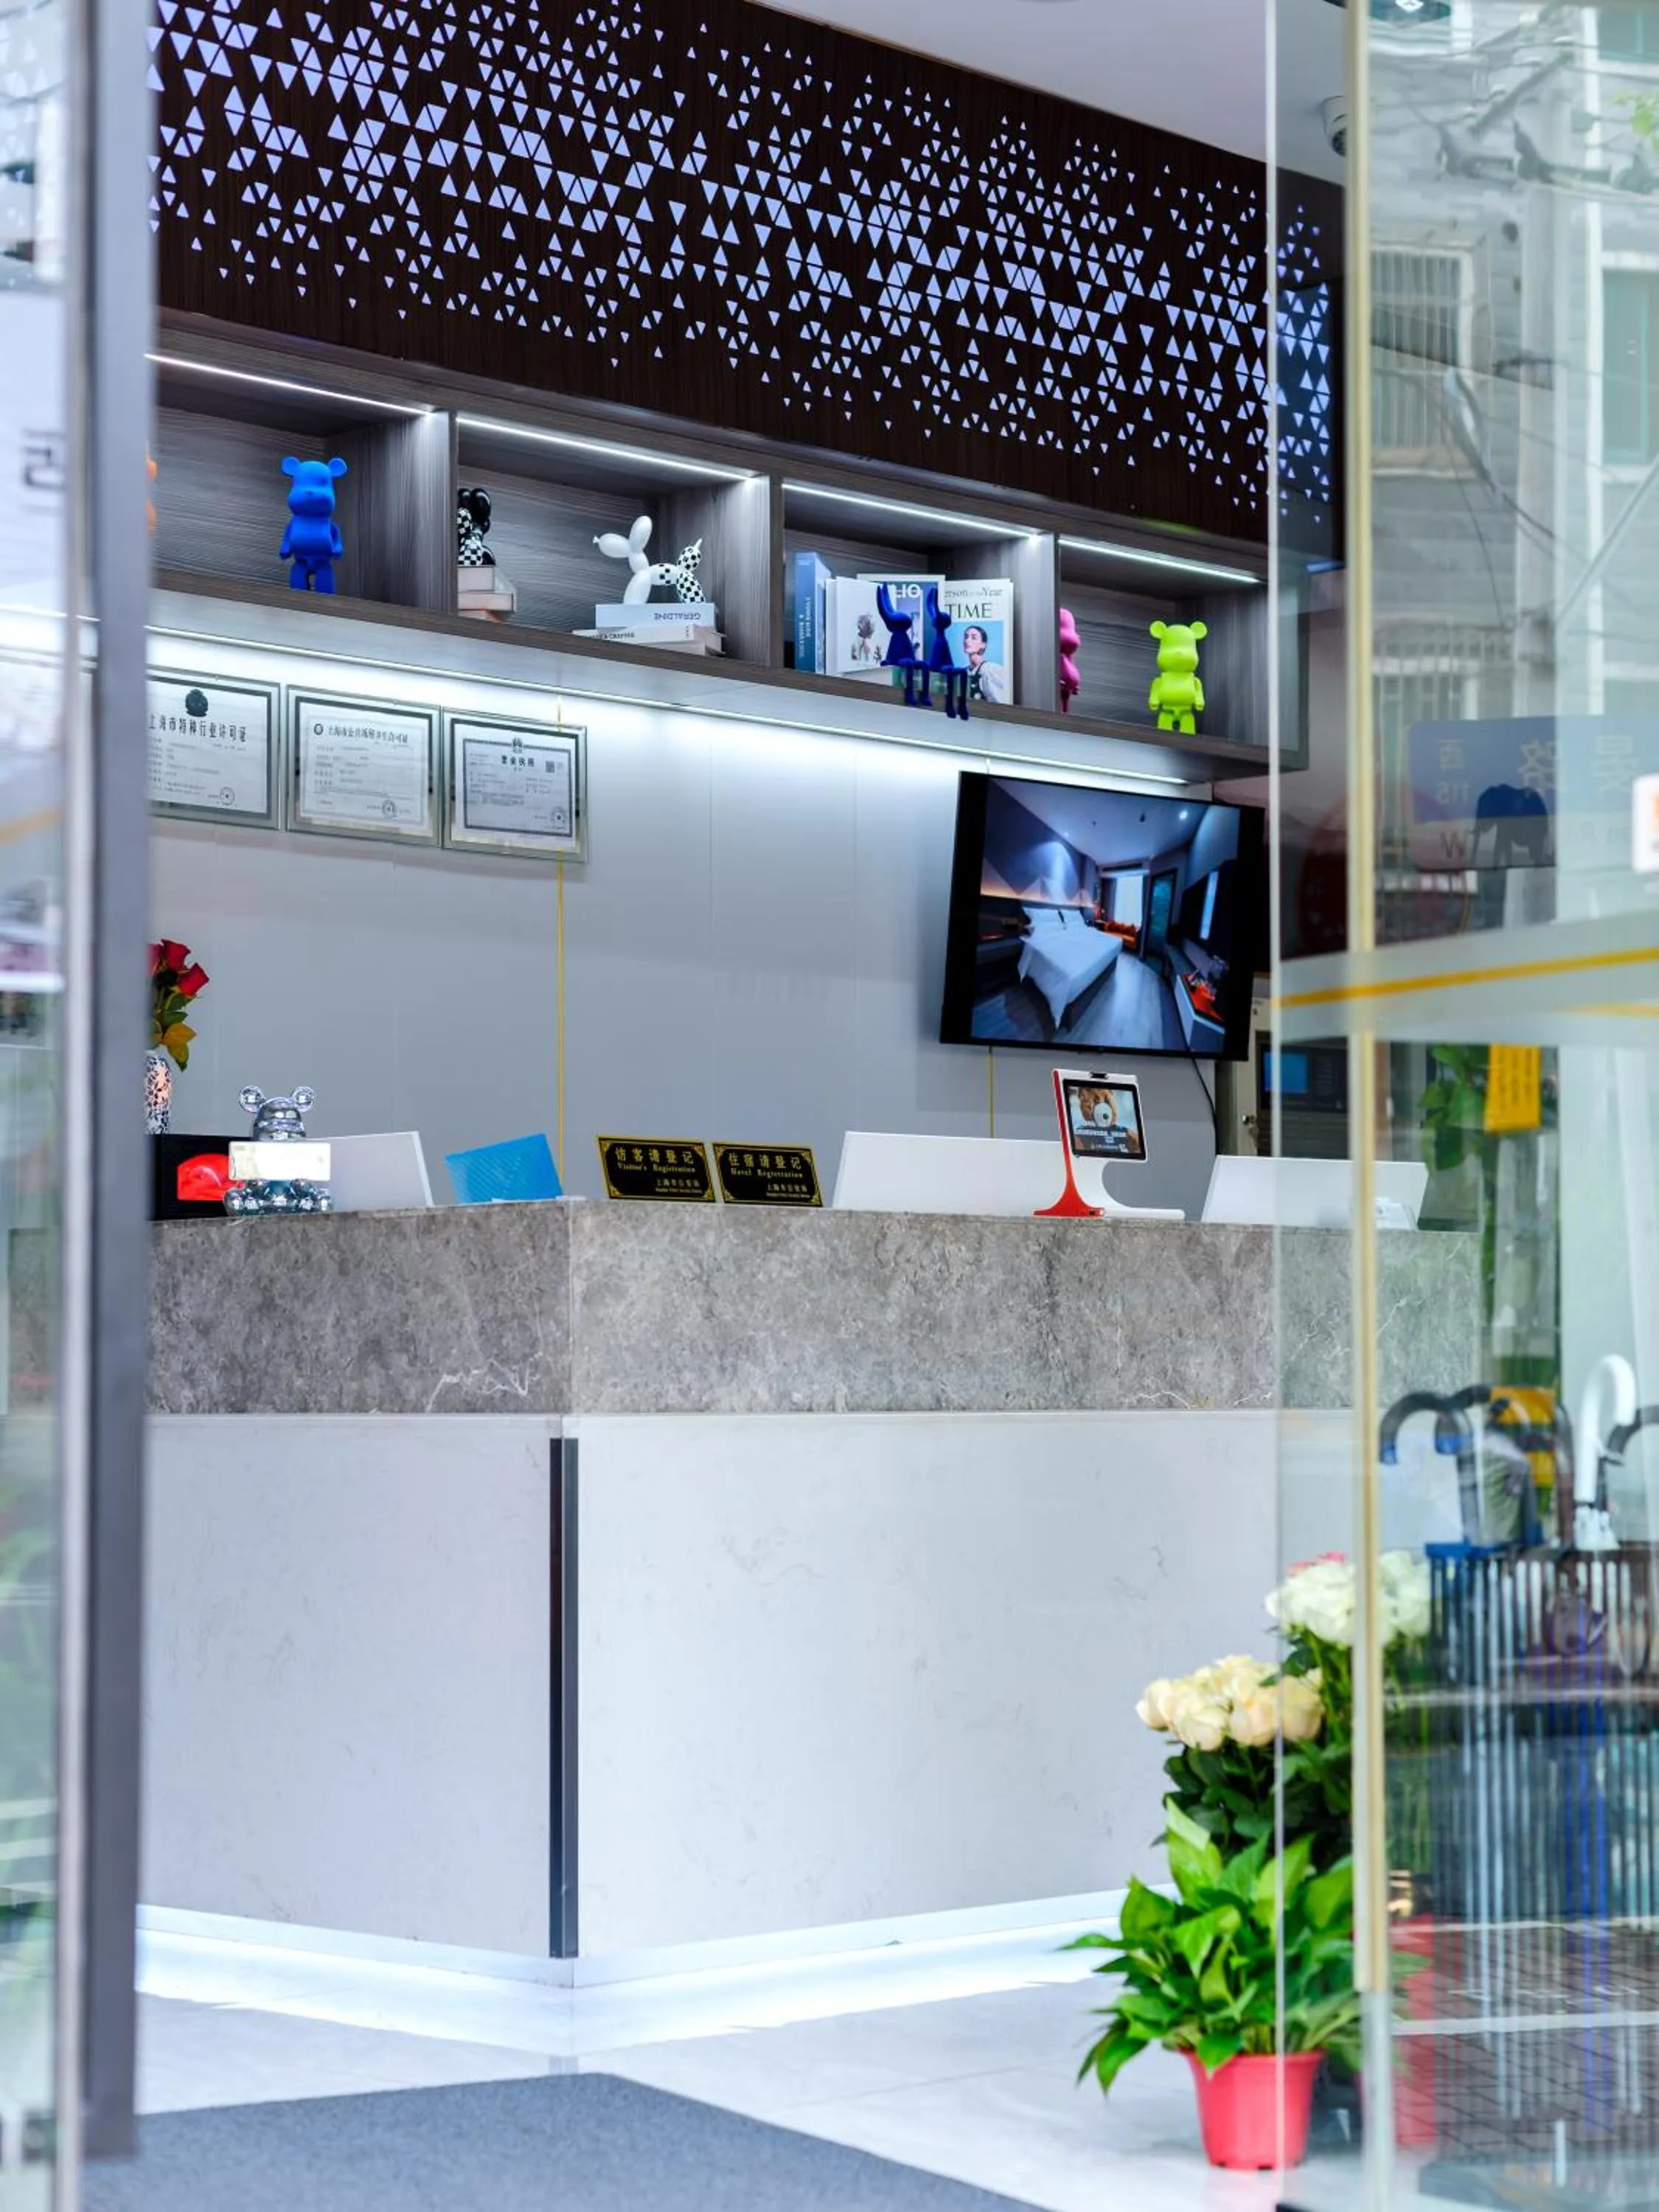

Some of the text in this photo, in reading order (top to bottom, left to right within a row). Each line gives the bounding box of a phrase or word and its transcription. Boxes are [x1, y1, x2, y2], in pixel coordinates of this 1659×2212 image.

[945, 602, 992, 619] TIME
[614, 1146, 694, 1164] 访客请登记
[728, 1152, 801, 1170] 住宿请登记
[653, 1163, 696, 1174] Registration
